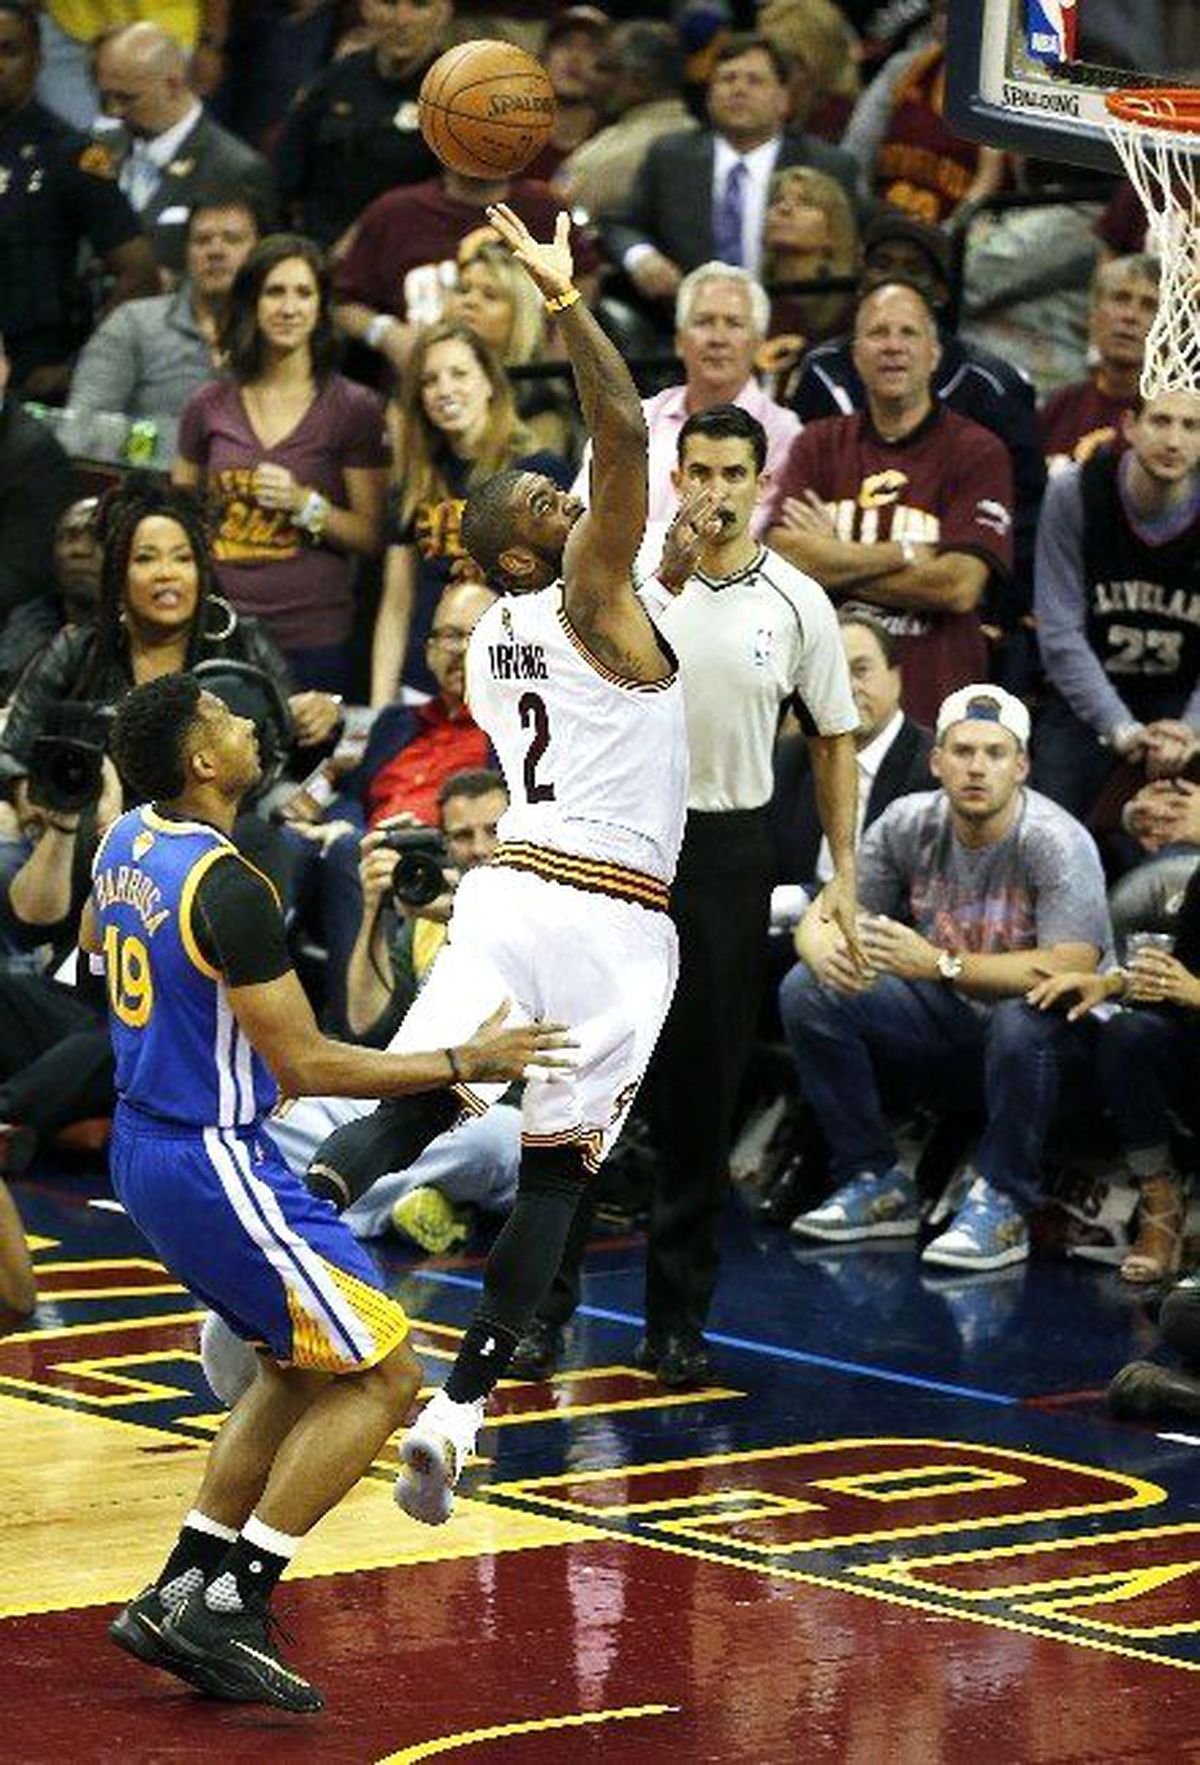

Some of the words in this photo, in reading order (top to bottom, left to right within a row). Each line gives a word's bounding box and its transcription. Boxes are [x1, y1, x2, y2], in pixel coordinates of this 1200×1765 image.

[1002, 83, 1081, 117] SPALDING
[487, 642, 549, 680] IRVING
[1104, 623, 1183, 674] 23
[518, 691, 556, 804] 2
[104, 923, 154, 1031] 19
